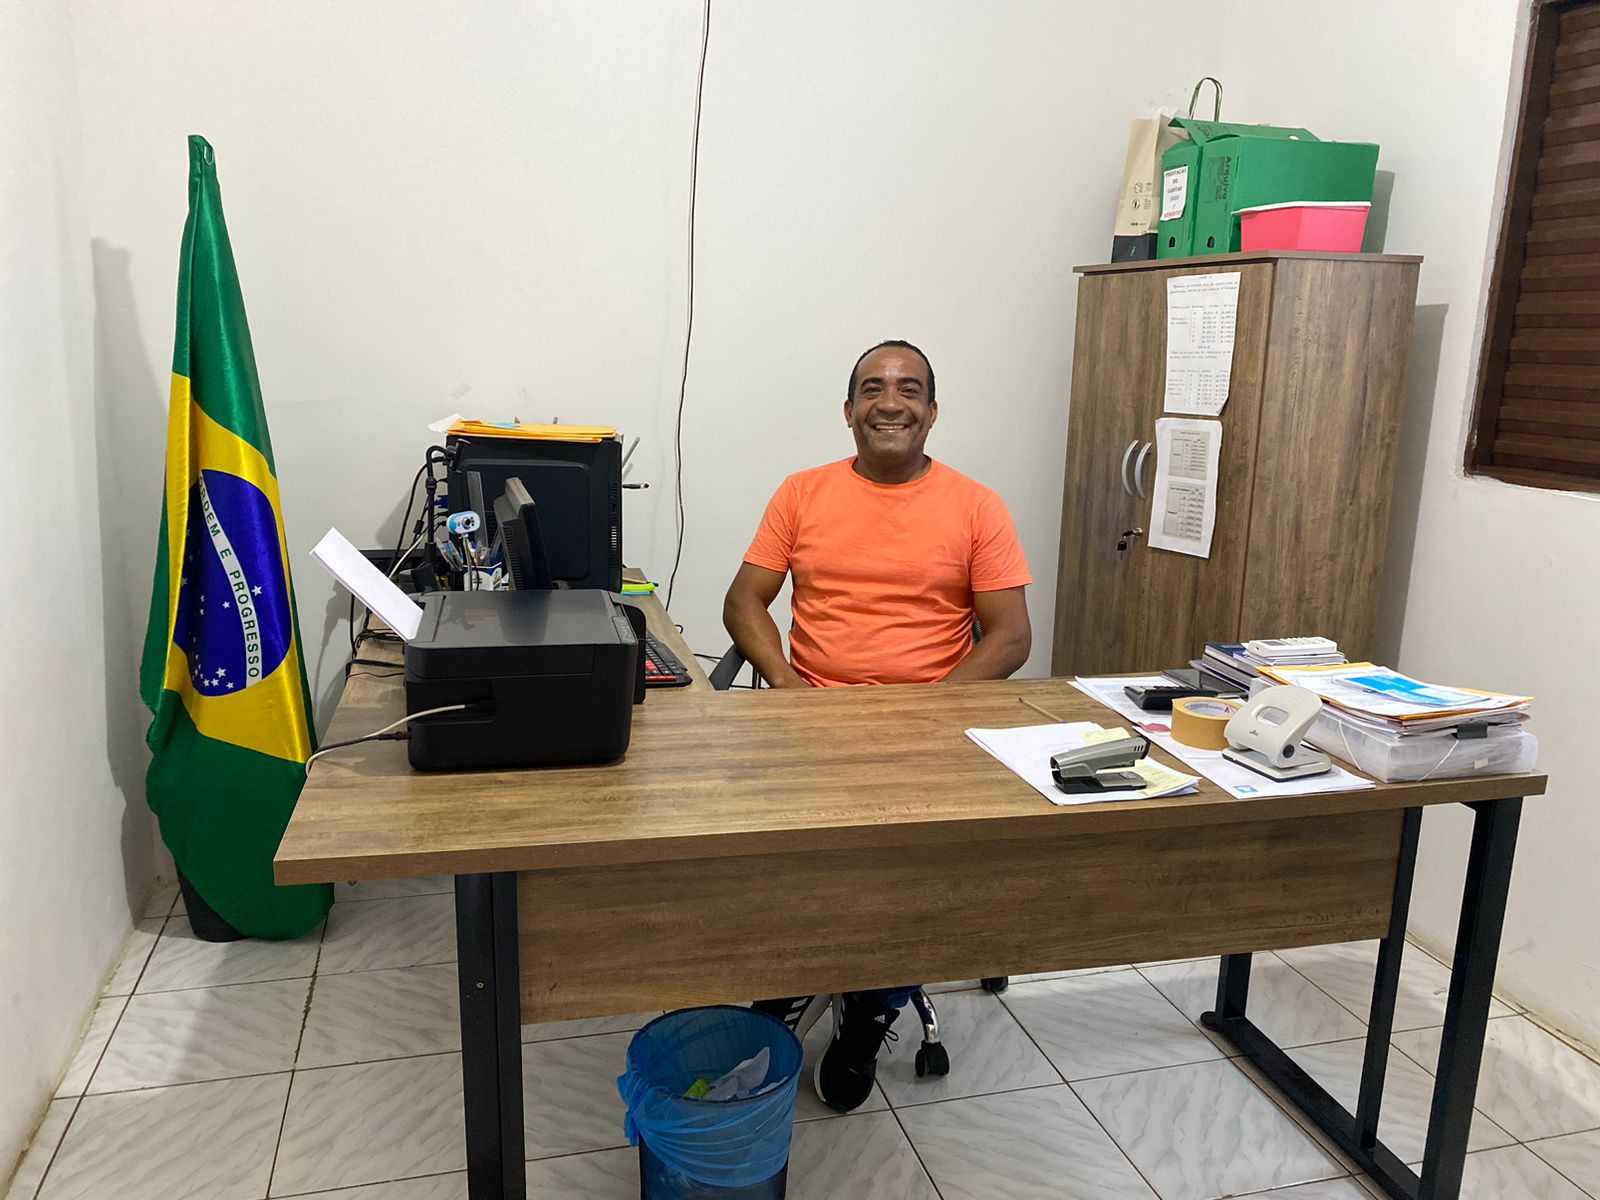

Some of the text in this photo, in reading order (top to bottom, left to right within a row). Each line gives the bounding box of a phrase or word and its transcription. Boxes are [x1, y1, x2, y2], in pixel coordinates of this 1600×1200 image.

[1223, 156, 1232, 200] Arquivo
[199, 476, 260, 678] ORDEM E PROGRESSO
